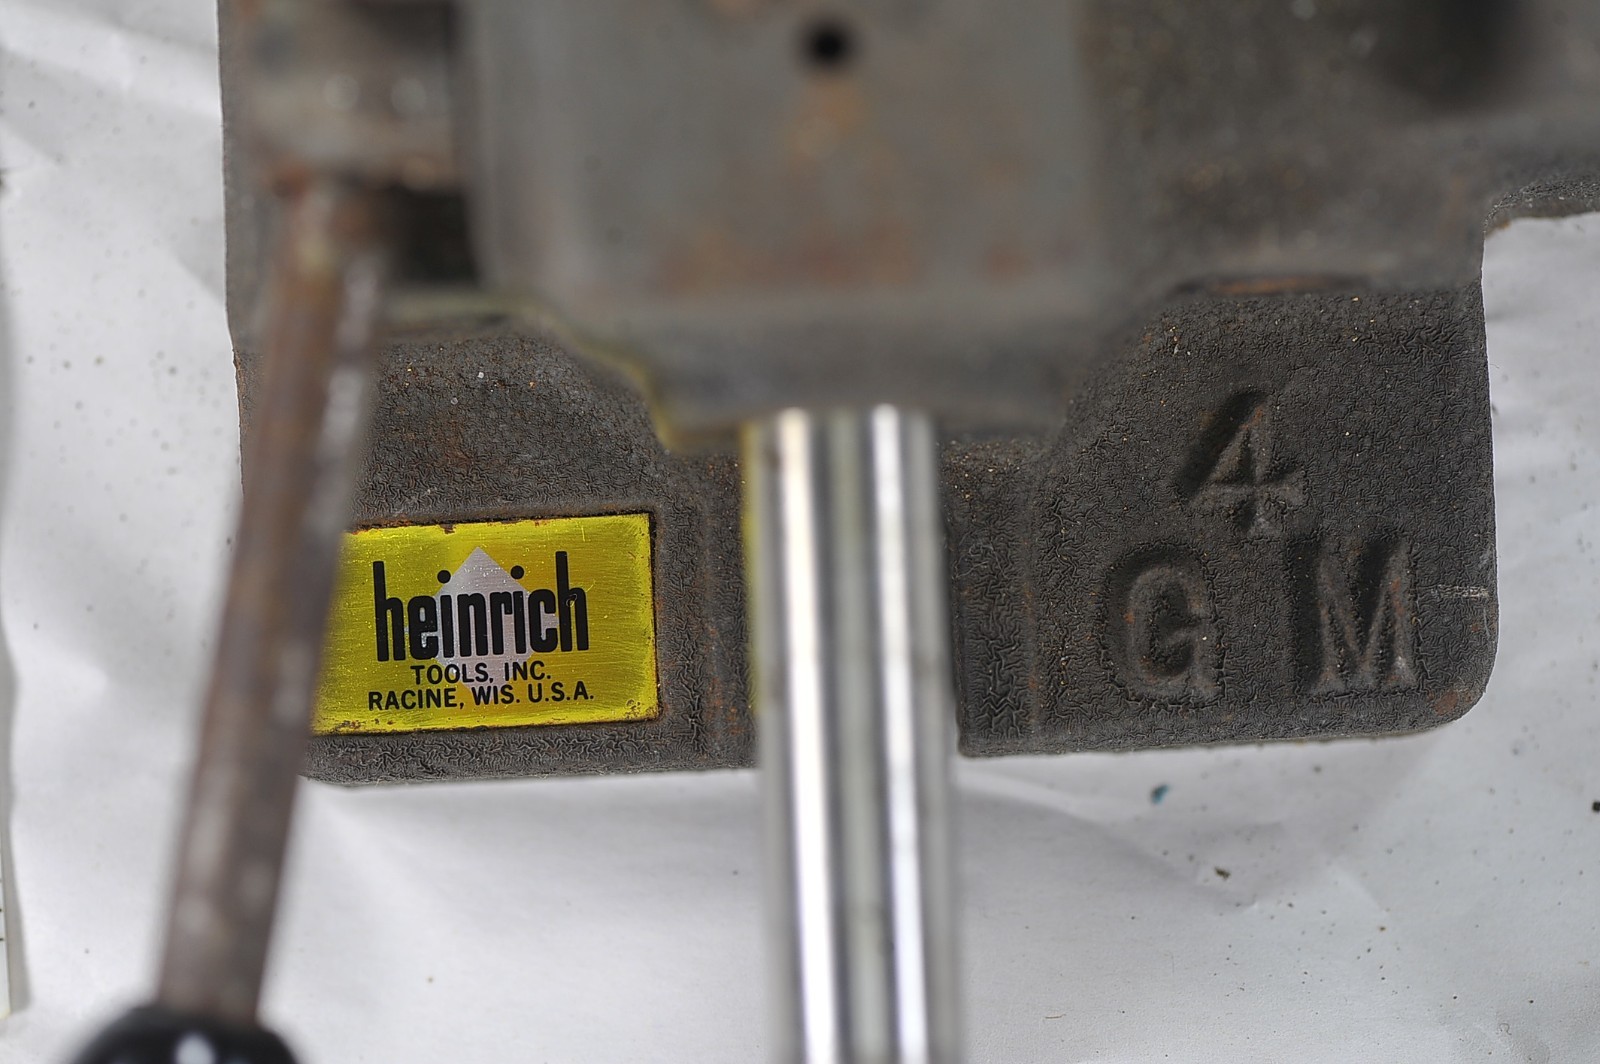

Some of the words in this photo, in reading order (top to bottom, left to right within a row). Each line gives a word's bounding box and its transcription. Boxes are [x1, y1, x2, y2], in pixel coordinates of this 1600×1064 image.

[1194, 395, 1302, 539] 4
[373, 550, 590, 662] heinrich
[368, 686, 465, 711] RACINE,
[472, 684, 521, 706] WIS.
[528, 681, 594, 703] U.S.A.
[410, 663, 494, 685] TOOLS,
[504, 660, 552, 682] INC.
